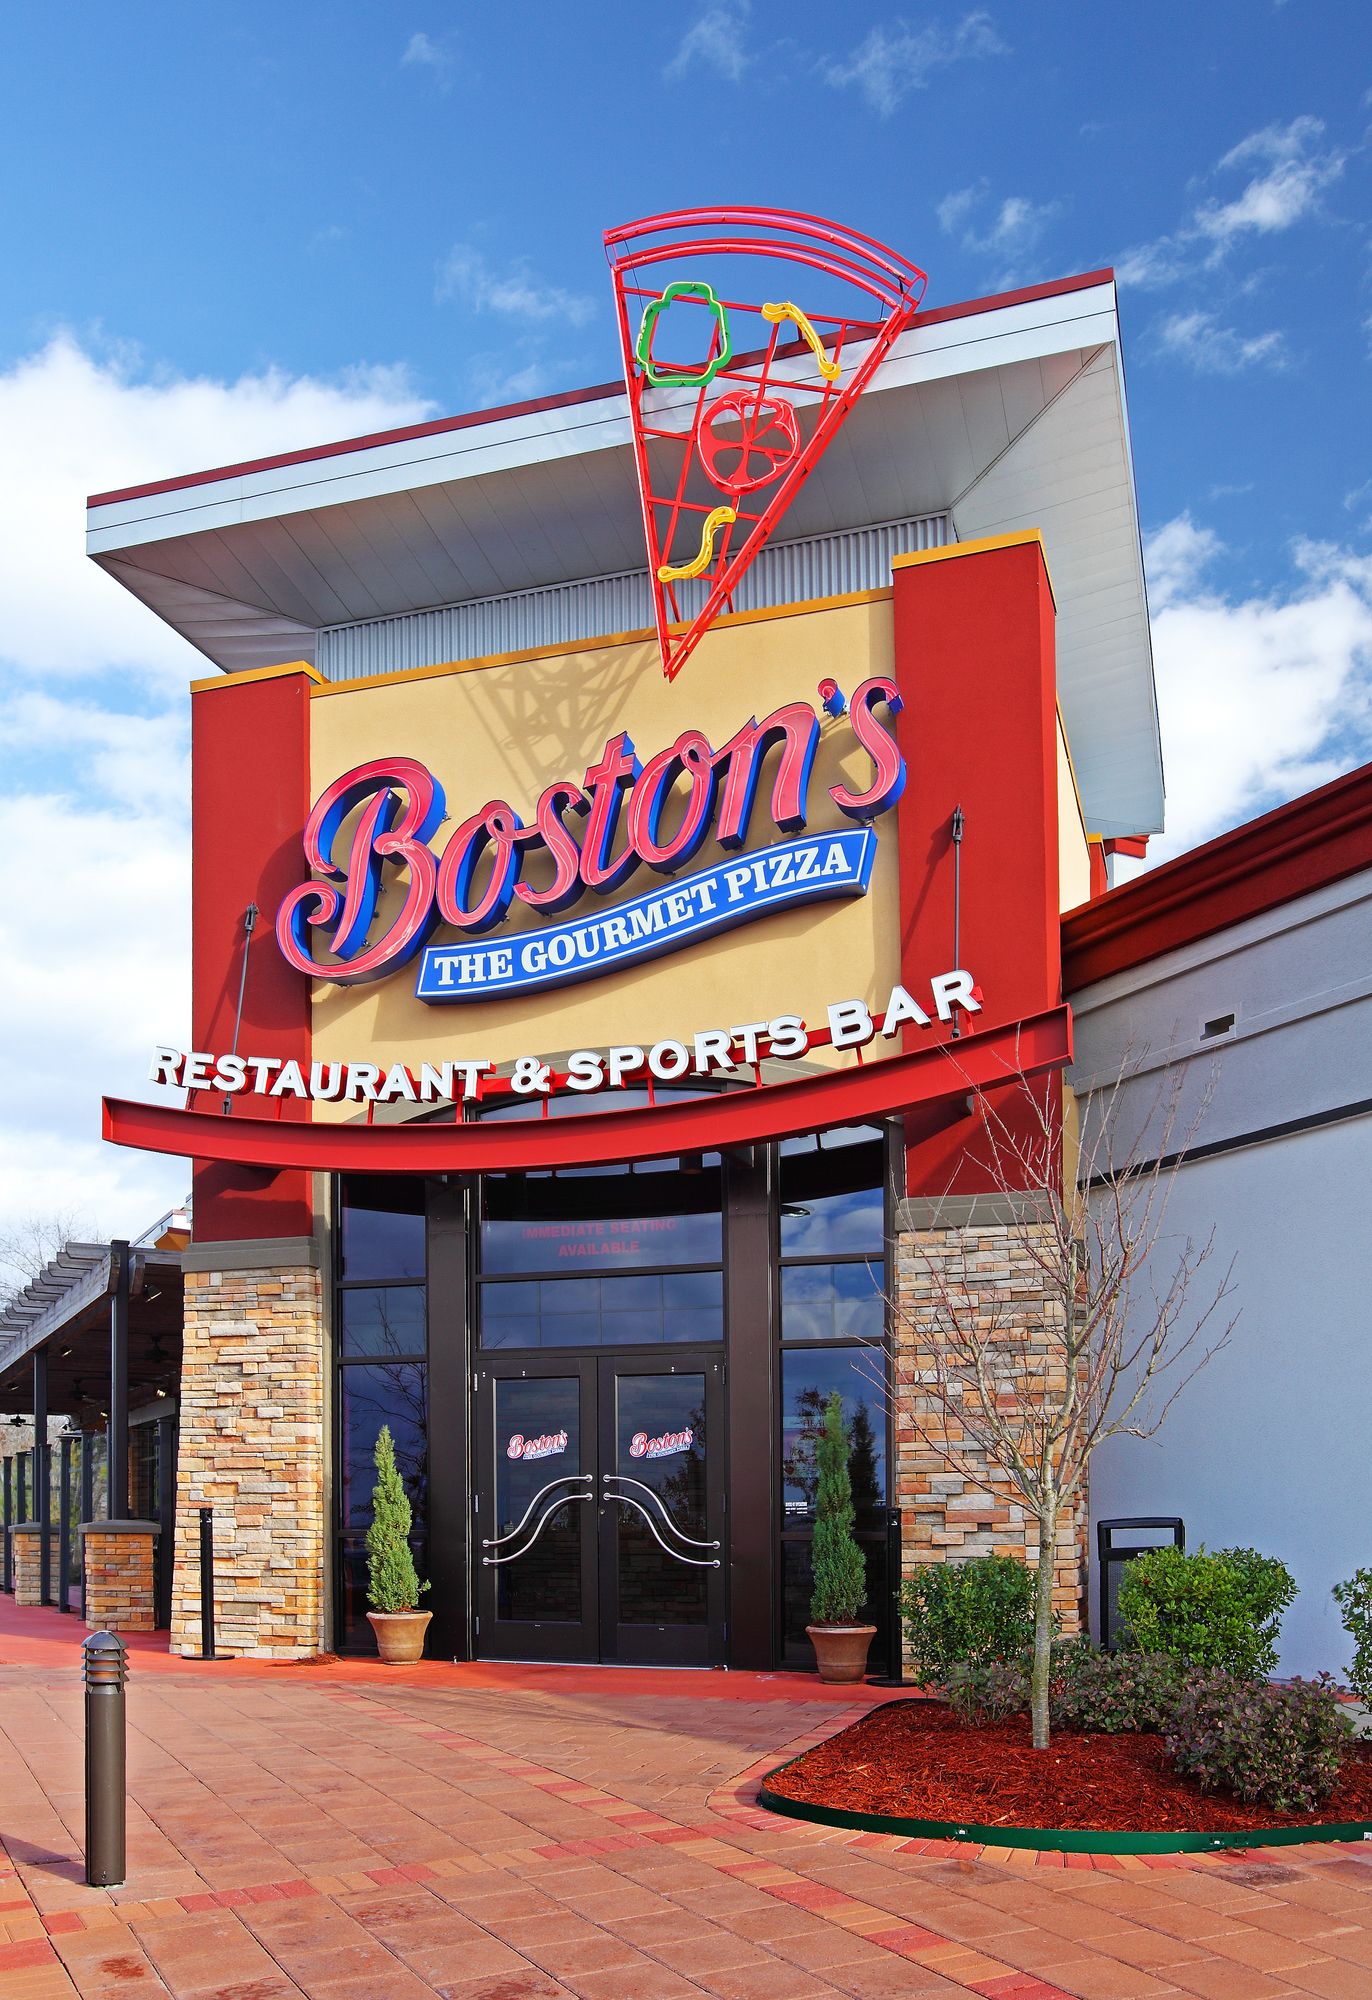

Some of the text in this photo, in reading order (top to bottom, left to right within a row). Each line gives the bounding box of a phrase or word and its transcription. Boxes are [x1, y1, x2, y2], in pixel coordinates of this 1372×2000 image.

[276, 676, 906, 982] Boston's
[434, 842, 852, 985] THE GOURMET PIZZA
[149, 969, 982, 1102] RESTAURANT & SPORTS BAR
[522, 1219, 677, 1239] IMMEDIATE SEATING
[558, 1241, 641, 1257] AVAILABLE
[507, 1429, 568, 1459] Boston's
[629, 1426, 693, 1457] Boston's
